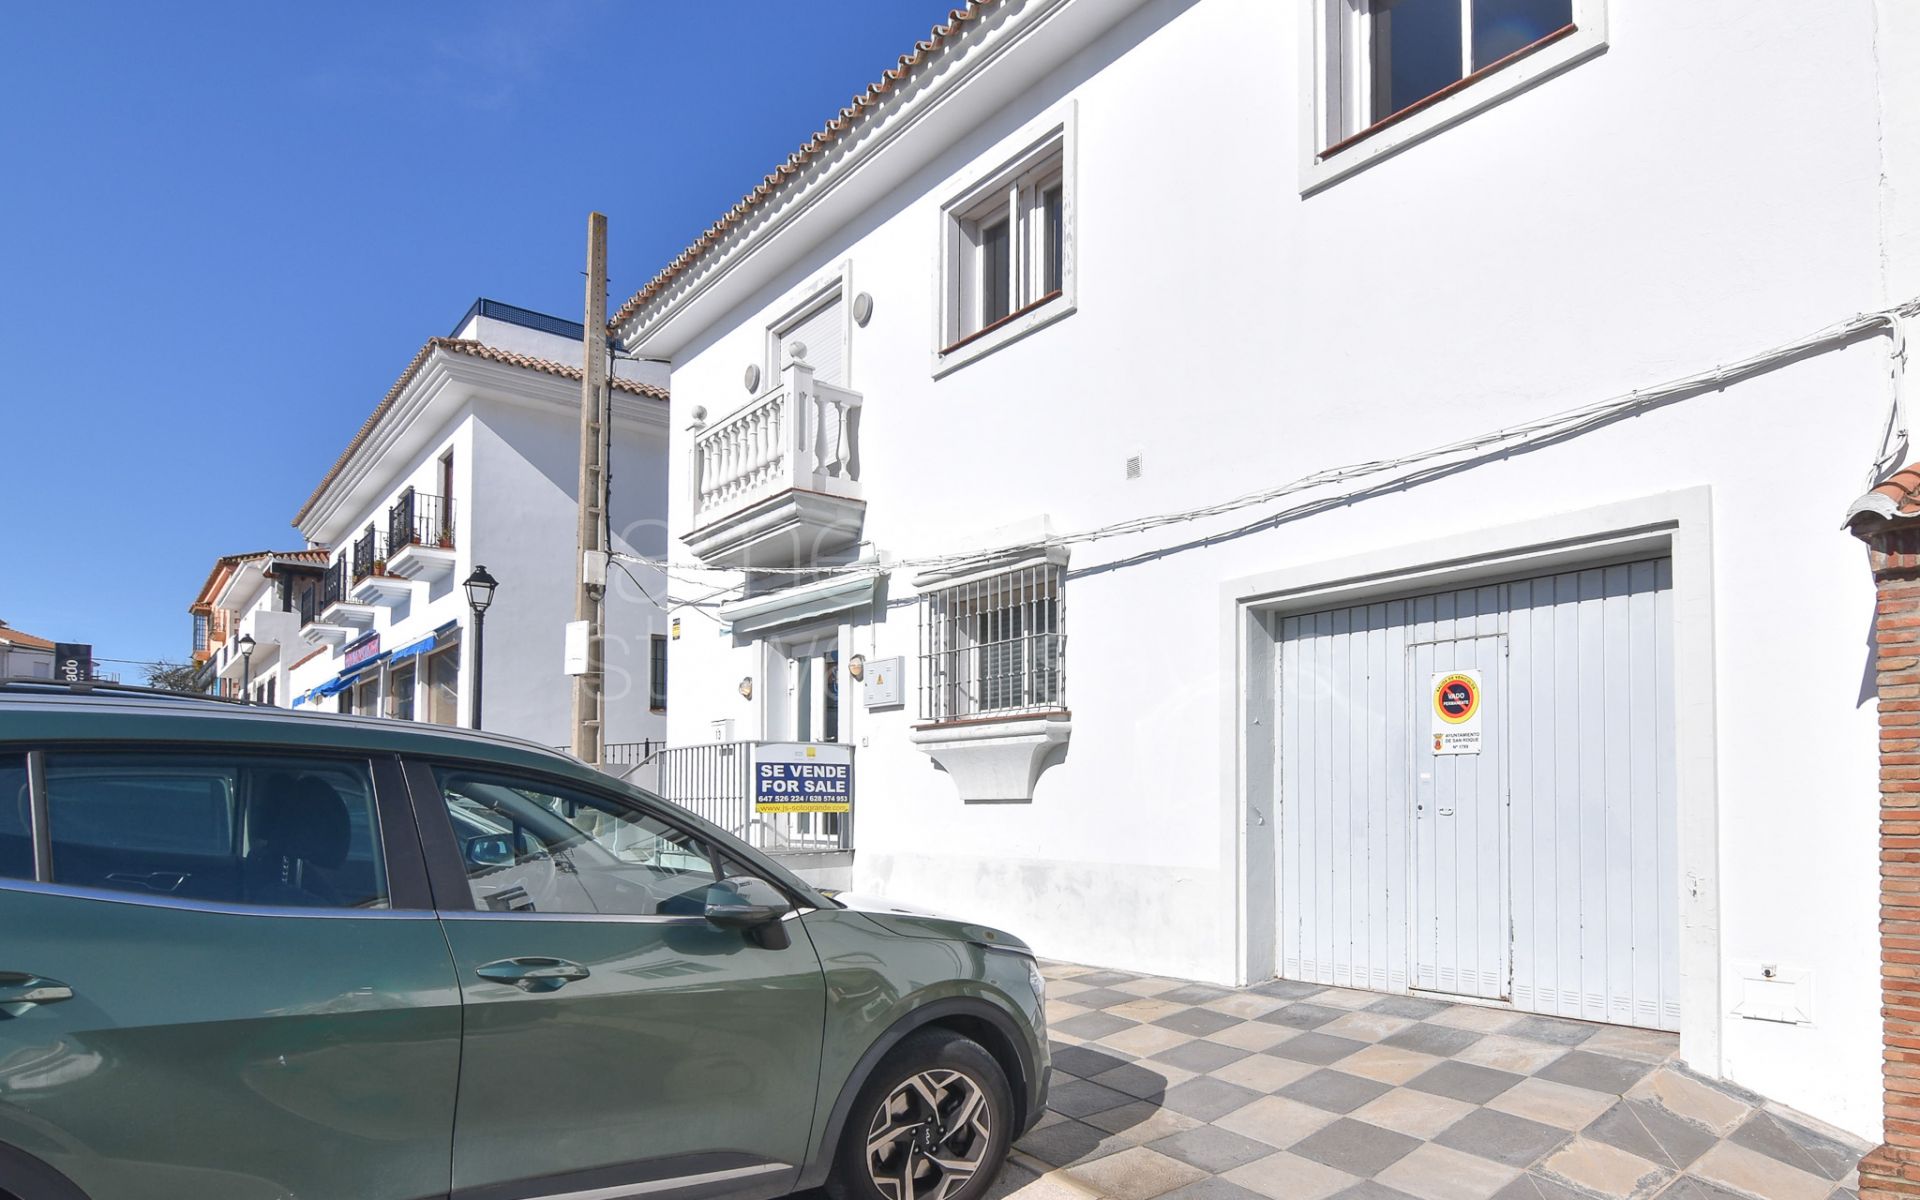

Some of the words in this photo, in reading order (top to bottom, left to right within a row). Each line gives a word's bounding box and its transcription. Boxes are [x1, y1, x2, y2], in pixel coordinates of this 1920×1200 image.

[61, 660, 78, 682] ado
[761, 765, 785, 777] SE
[790, 765, 847, 778] VENDE
[762, 780, 799, 792] FOR
[804, 780, 846, 792] SALE
